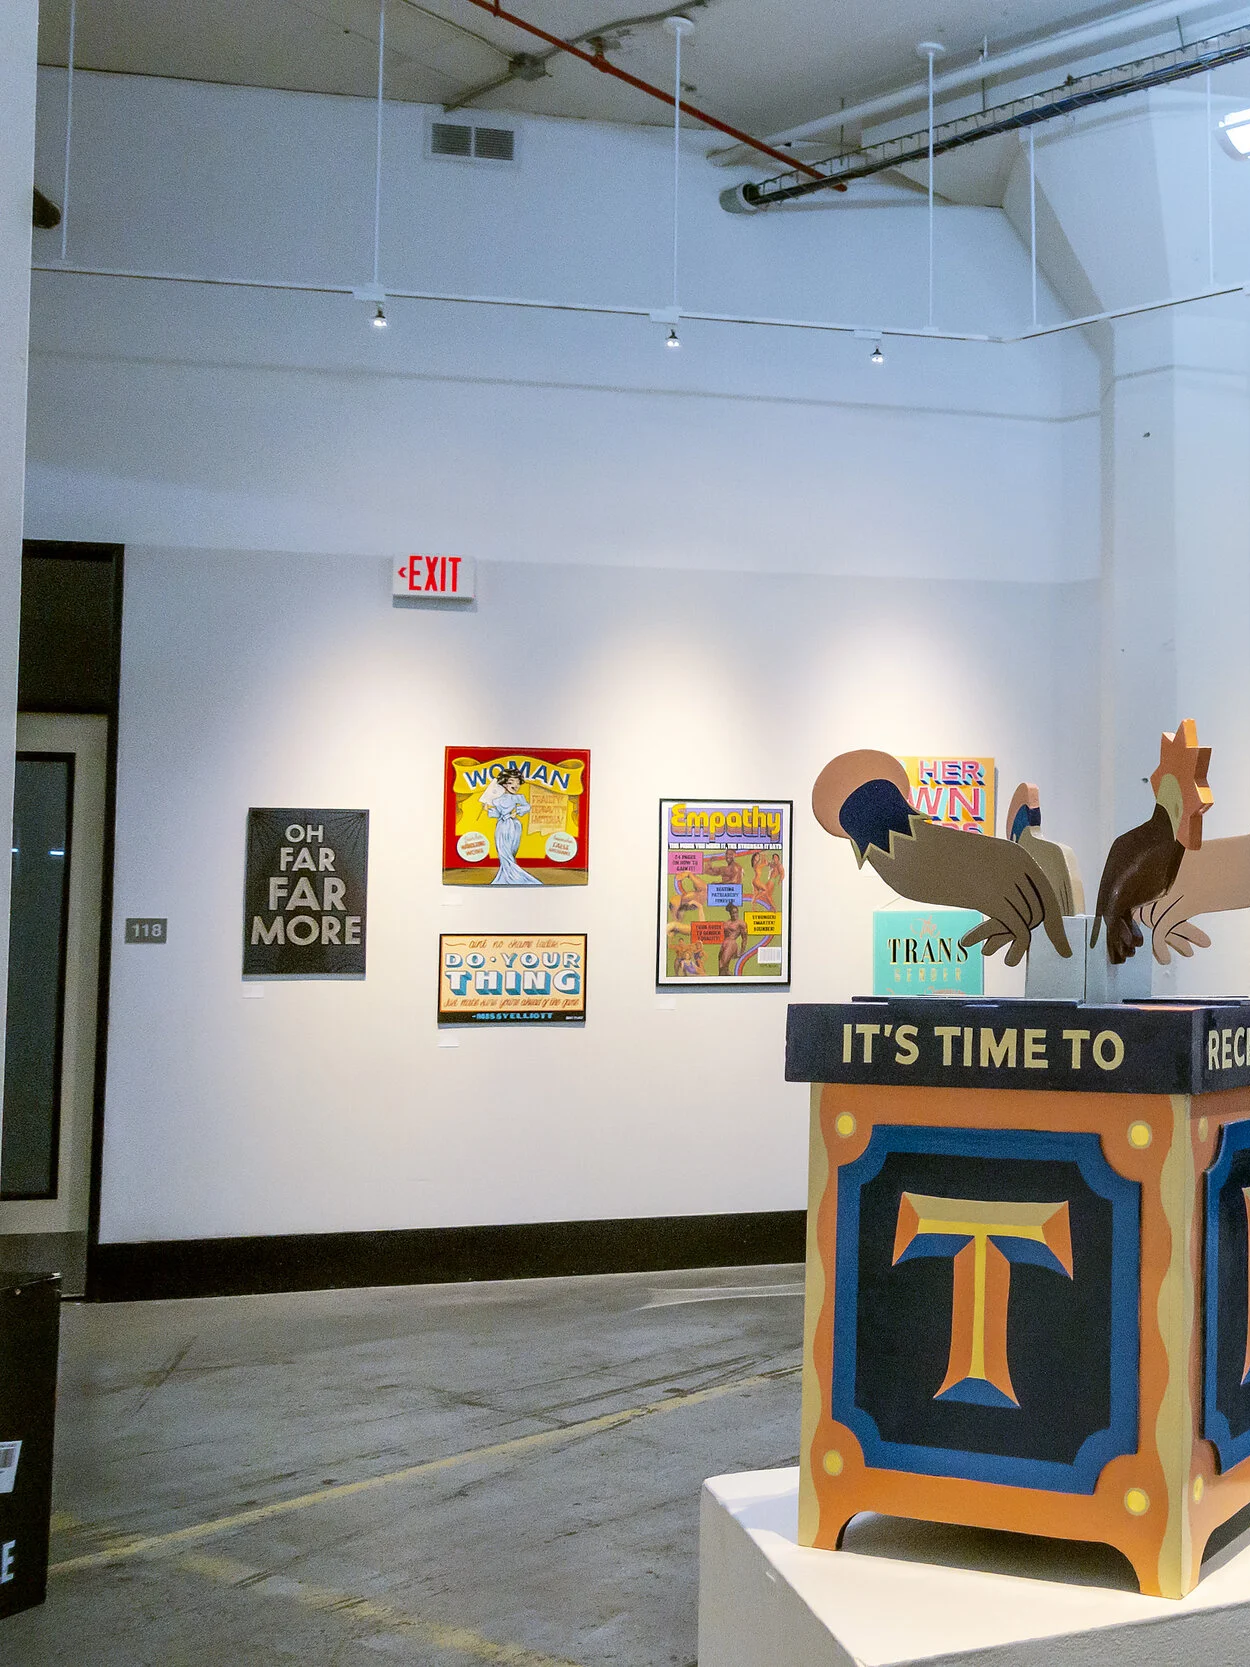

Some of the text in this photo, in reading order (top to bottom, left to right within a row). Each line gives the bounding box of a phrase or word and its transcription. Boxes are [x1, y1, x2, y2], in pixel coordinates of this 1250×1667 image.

[408, 555, 462, 592] EXIT
[462, 761, 571, 790] WOMAN
[919, 760, 986, 785] HER
[909, 787, 985, 822] WN
[285, 824, 324, 843] OH
[671, 803, 781, 842] Empathy
[280, 847, 336, 872] FAR
[268, 877, 347, 911] FAR
[131, 923, 162, 937] 118
[250, 915, 361, 946] MORE
[909, 914, 941, 939] The
[444, 952, 581, 969] DO YOUR
[887, 938, 969, 965] TRANS
[444, 969, 581, 996] THING
[893, 967, 962, 982] GENDER
[842, 1023, 1126, 1070] IT'S TIME TO
[892, 1191, 1074, 1409] T
